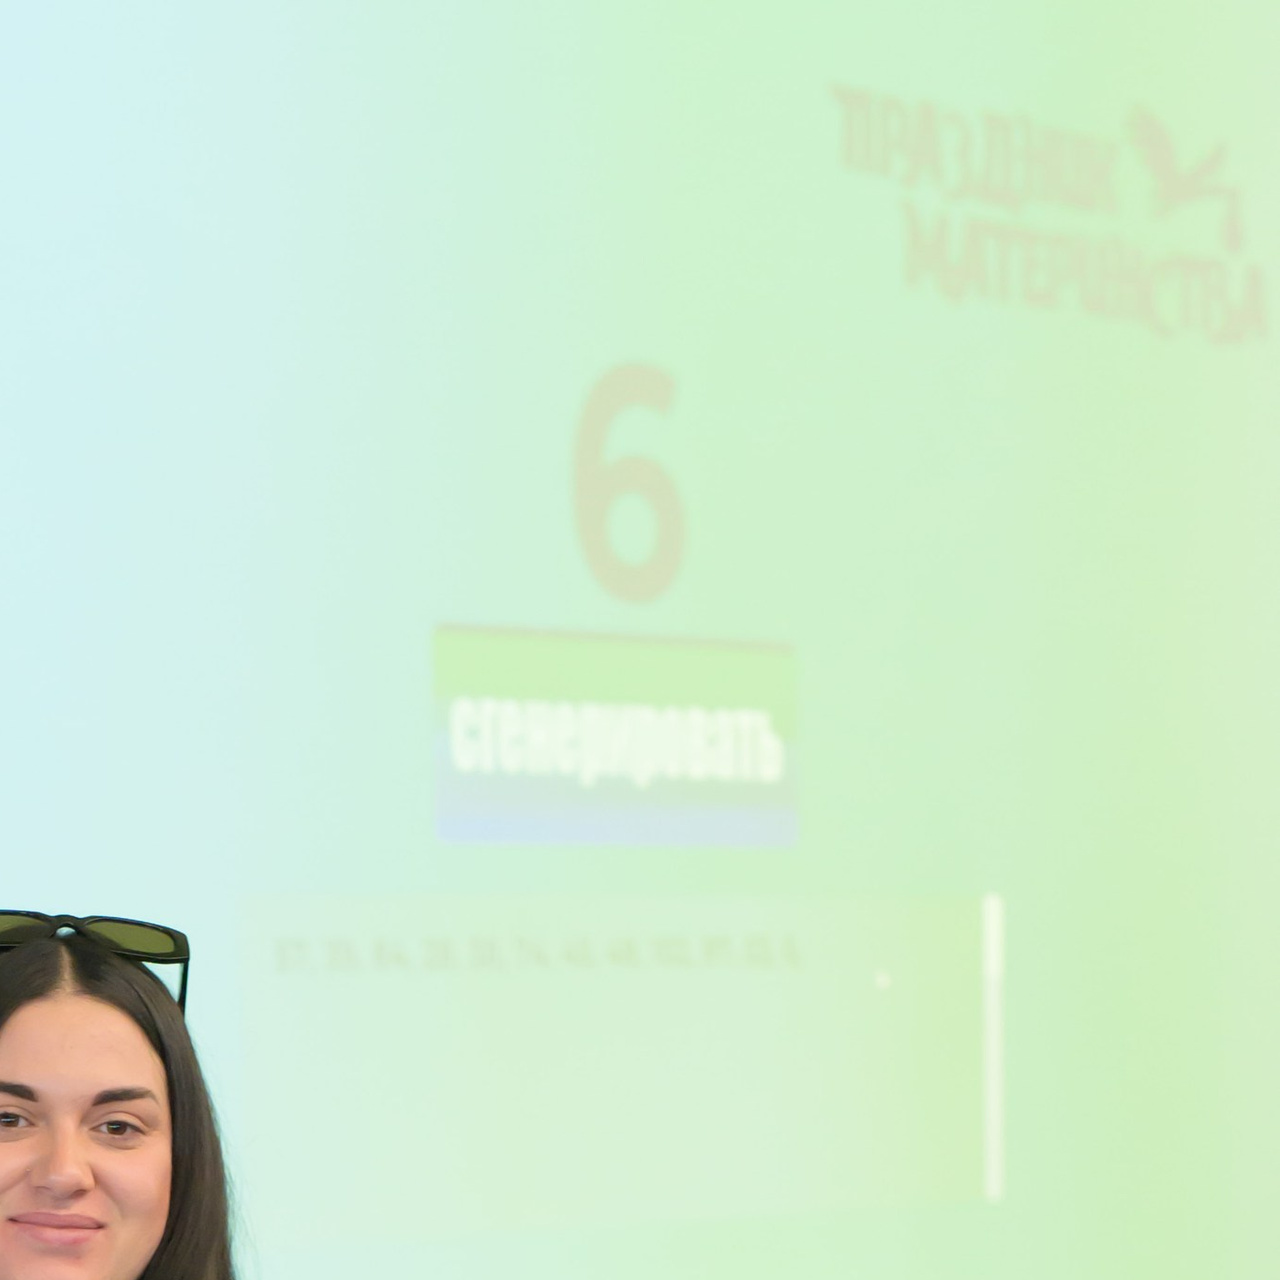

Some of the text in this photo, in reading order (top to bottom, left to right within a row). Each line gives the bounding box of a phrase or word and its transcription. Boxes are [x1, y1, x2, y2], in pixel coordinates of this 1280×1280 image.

[826, 80, 1119, 214] ПРАЗДНИК
[900, 196, 1268, 346] МАТЕРИНСТВА
[571, 361, 687, 604] 6
[449, 696, 785, 789] сгенерировать
